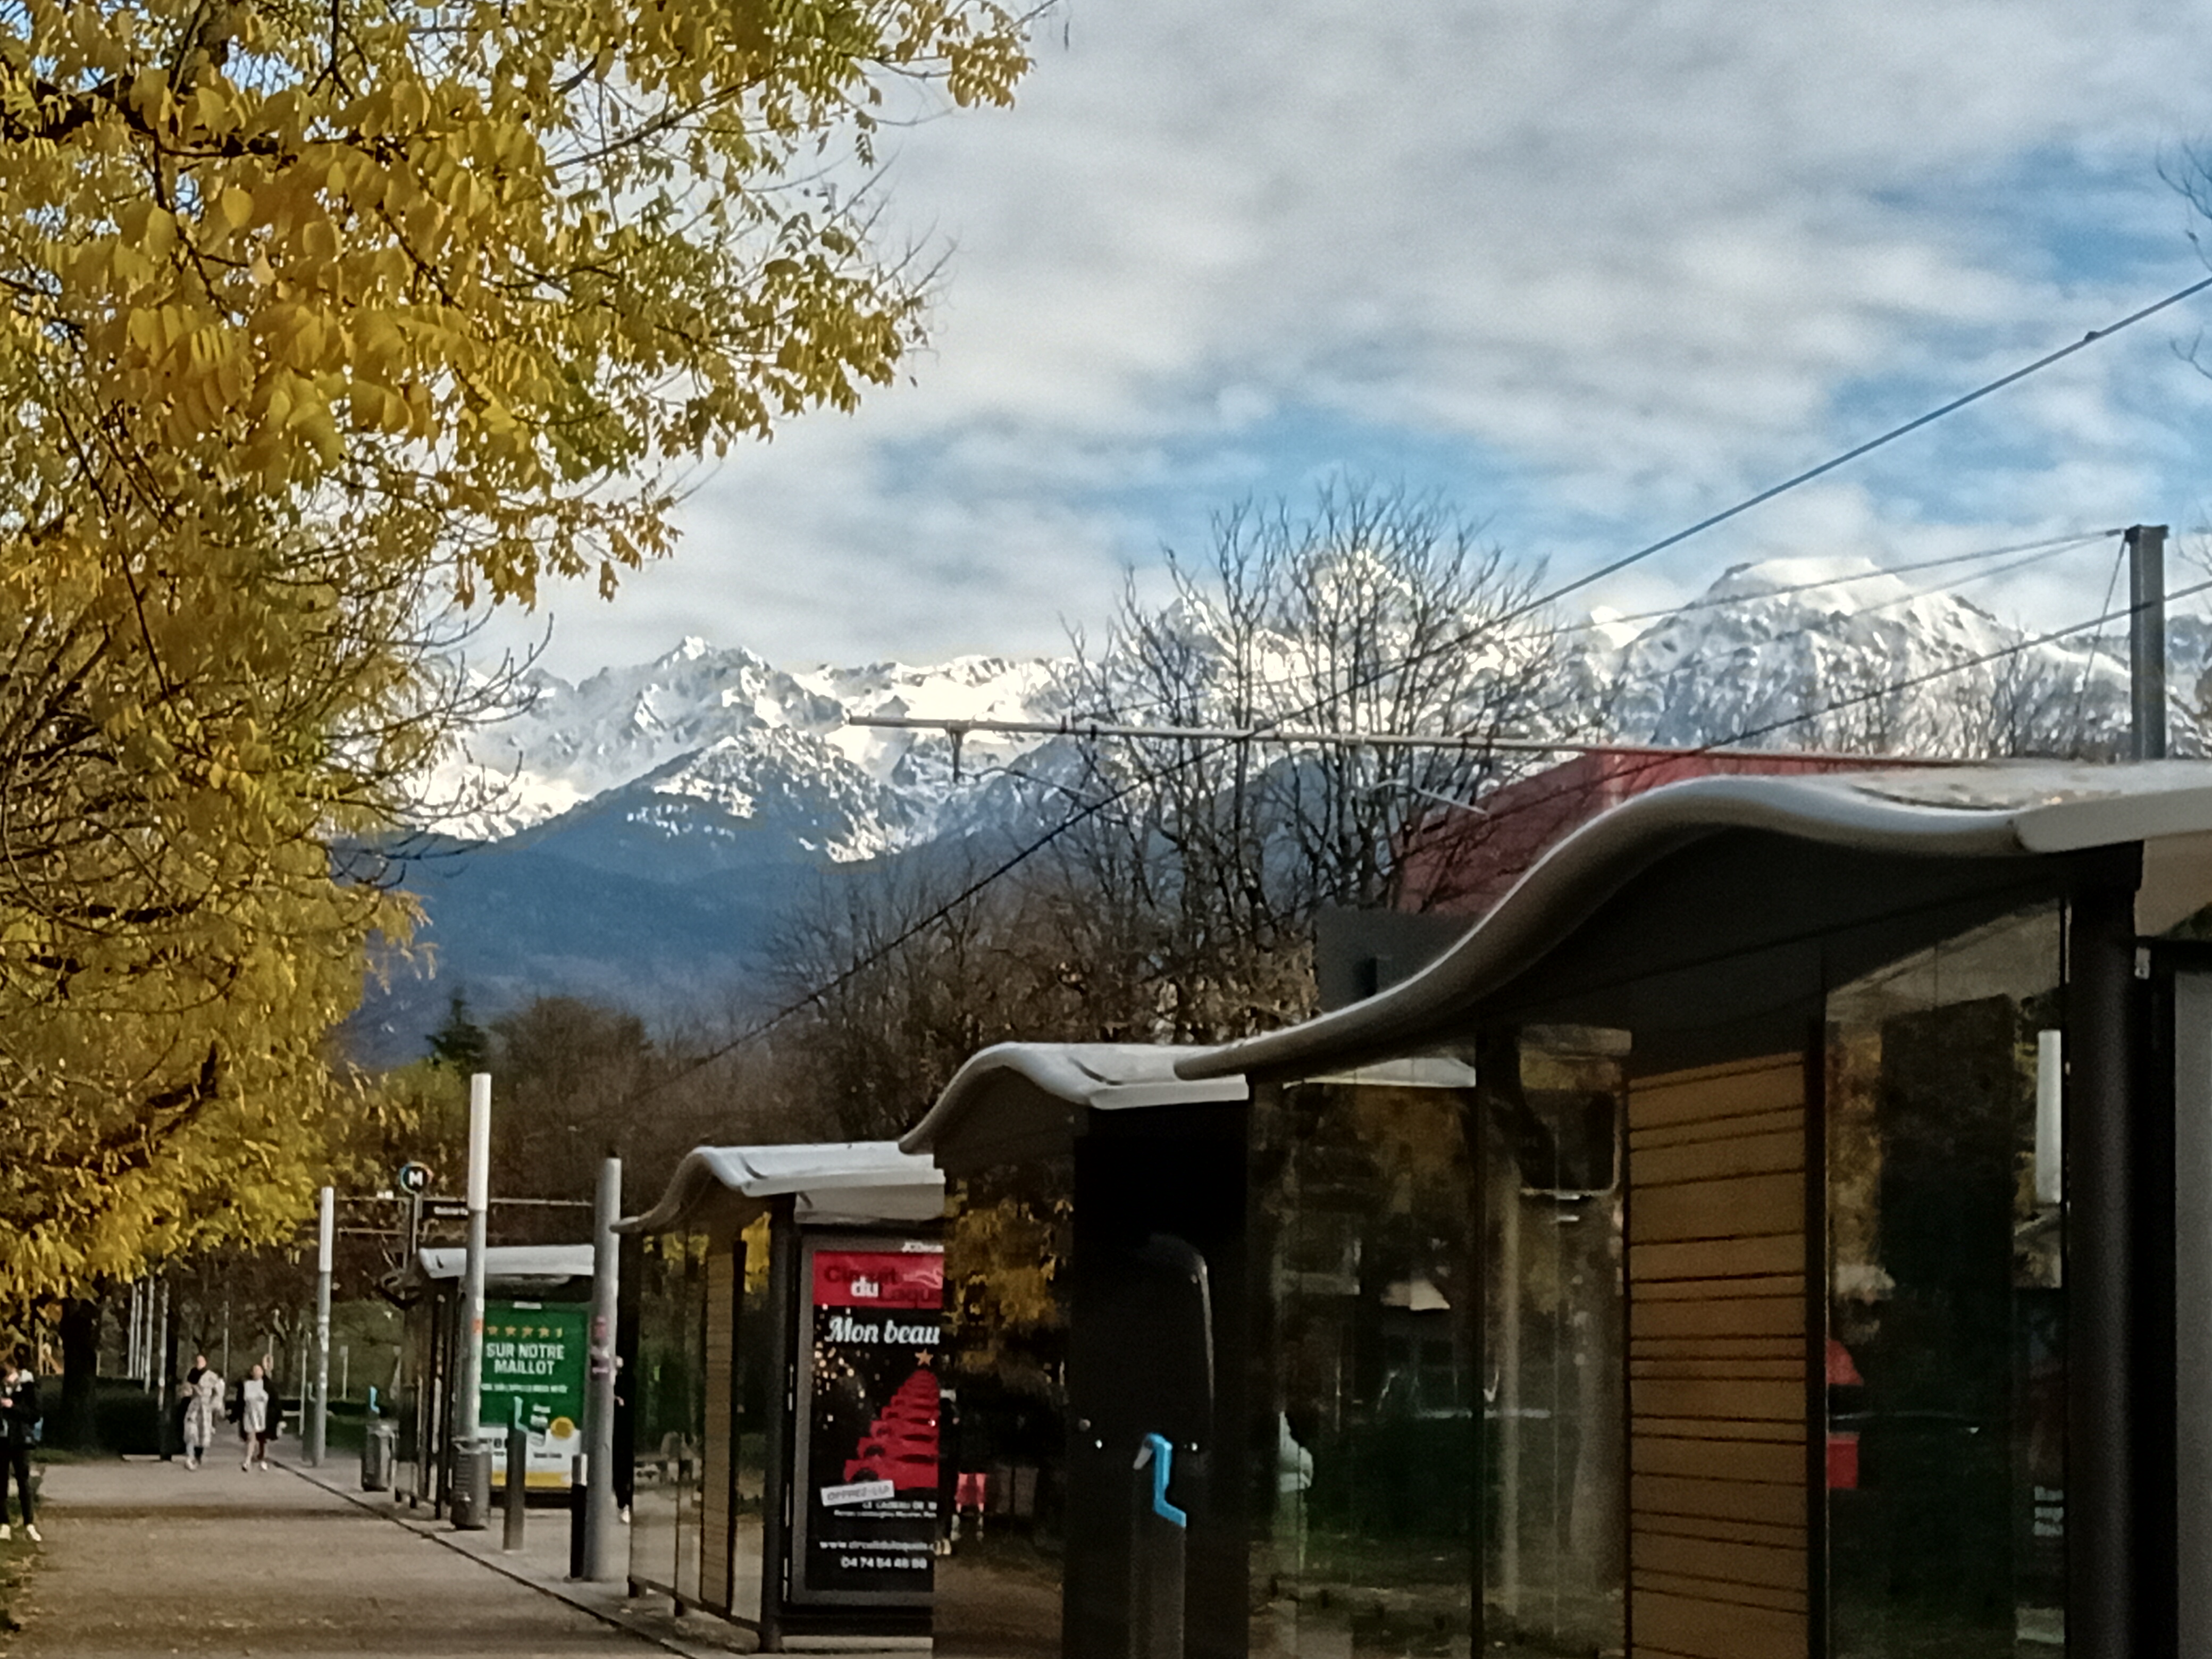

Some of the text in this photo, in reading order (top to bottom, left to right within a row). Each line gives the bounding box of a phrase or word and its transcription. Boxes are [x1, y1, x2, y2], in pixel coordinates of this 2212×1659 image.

[408, 1170, 423, 1187] M
[850, 1276, 879, 1297] du
[824, 1315, 941, 1345] Mon beau
[486, 1343, 565, 1360] SUR NOTRE
[494, 1359, 555, 1375] MAILLOT
[841, 1556, 858, 1568] 04
[860, 1556, 874, 1568] 74
